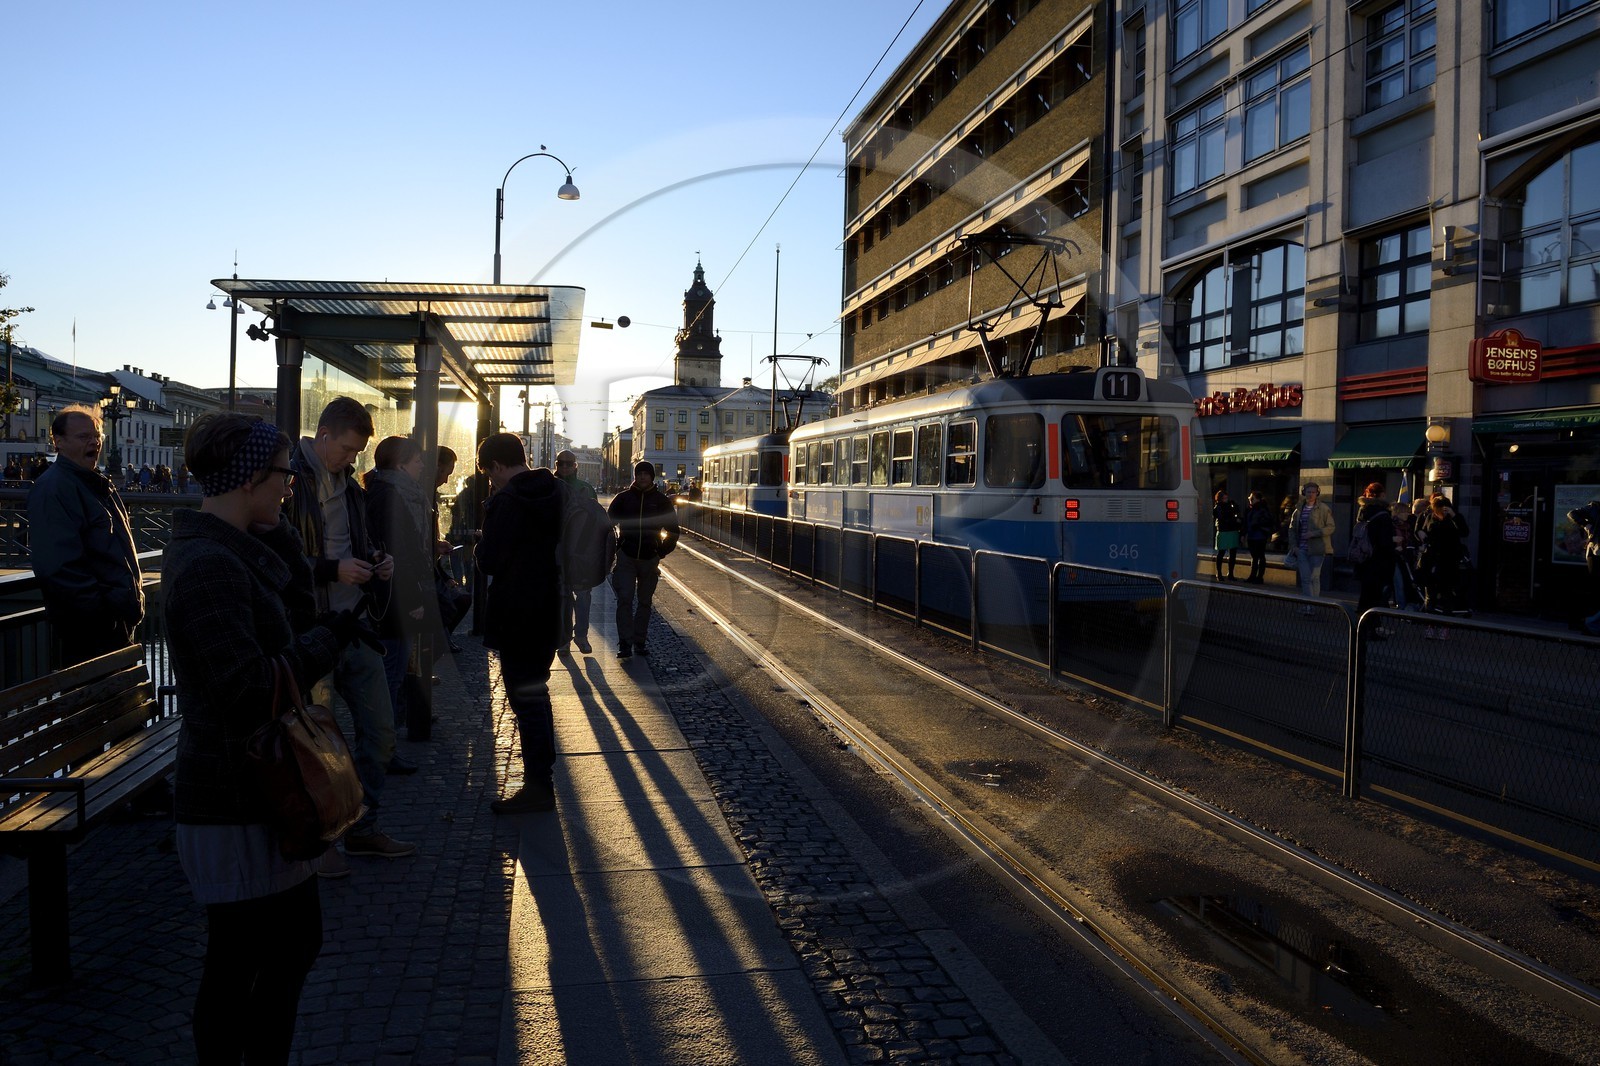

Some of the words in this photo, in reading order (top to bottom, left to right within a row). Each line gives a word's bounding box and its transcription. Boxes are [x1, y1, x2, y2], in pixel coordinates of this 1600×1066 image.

[1486, 347, 1537, 360] JENSEN'S
[1488, 359, 1536, 371] BØFHUS
[1107, 374, 1129, 396] 11
[1109, 544, 1138, 559] 846
